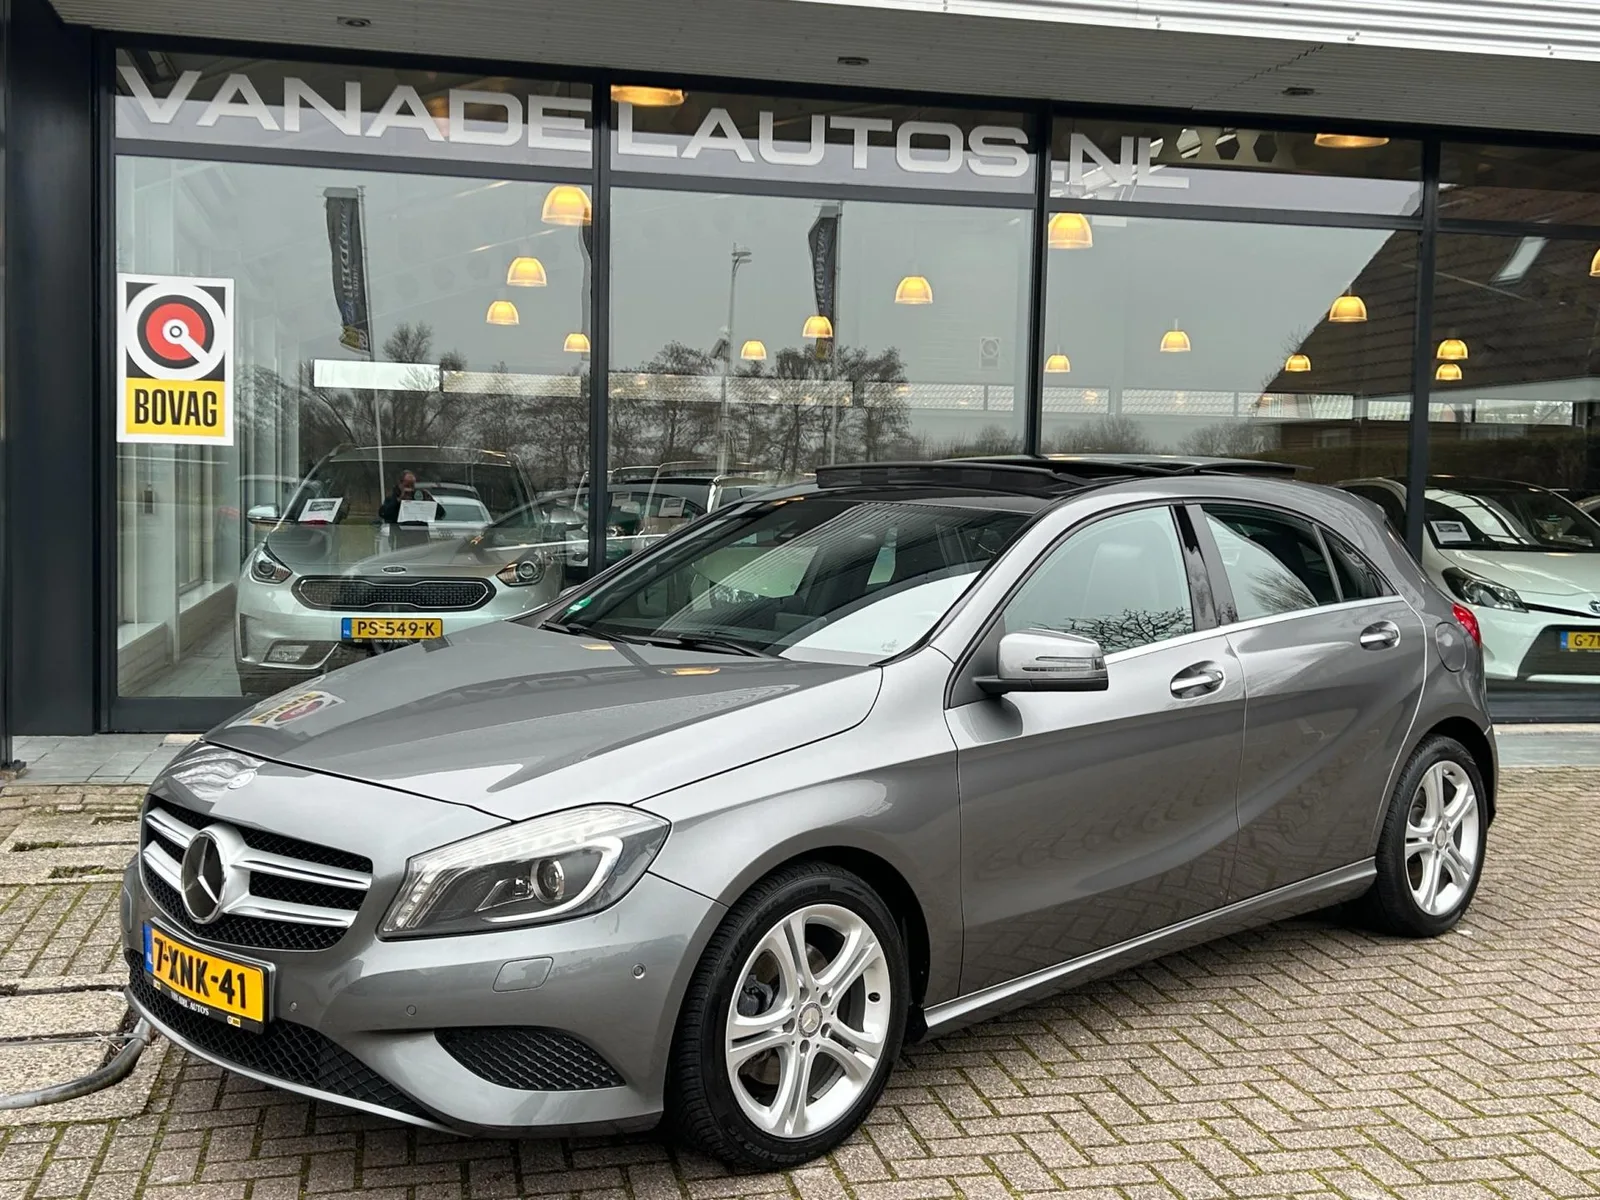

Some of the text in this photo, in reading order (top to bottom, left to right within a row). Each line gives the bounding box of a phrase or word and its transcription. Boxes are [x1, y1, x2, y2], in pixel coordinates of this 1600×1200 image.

[134, 389, 217, 427] BOVAG
[357, 621, 435, 636] PS-549-K
[154, 936, 246, 1010] 7-XNK-41
